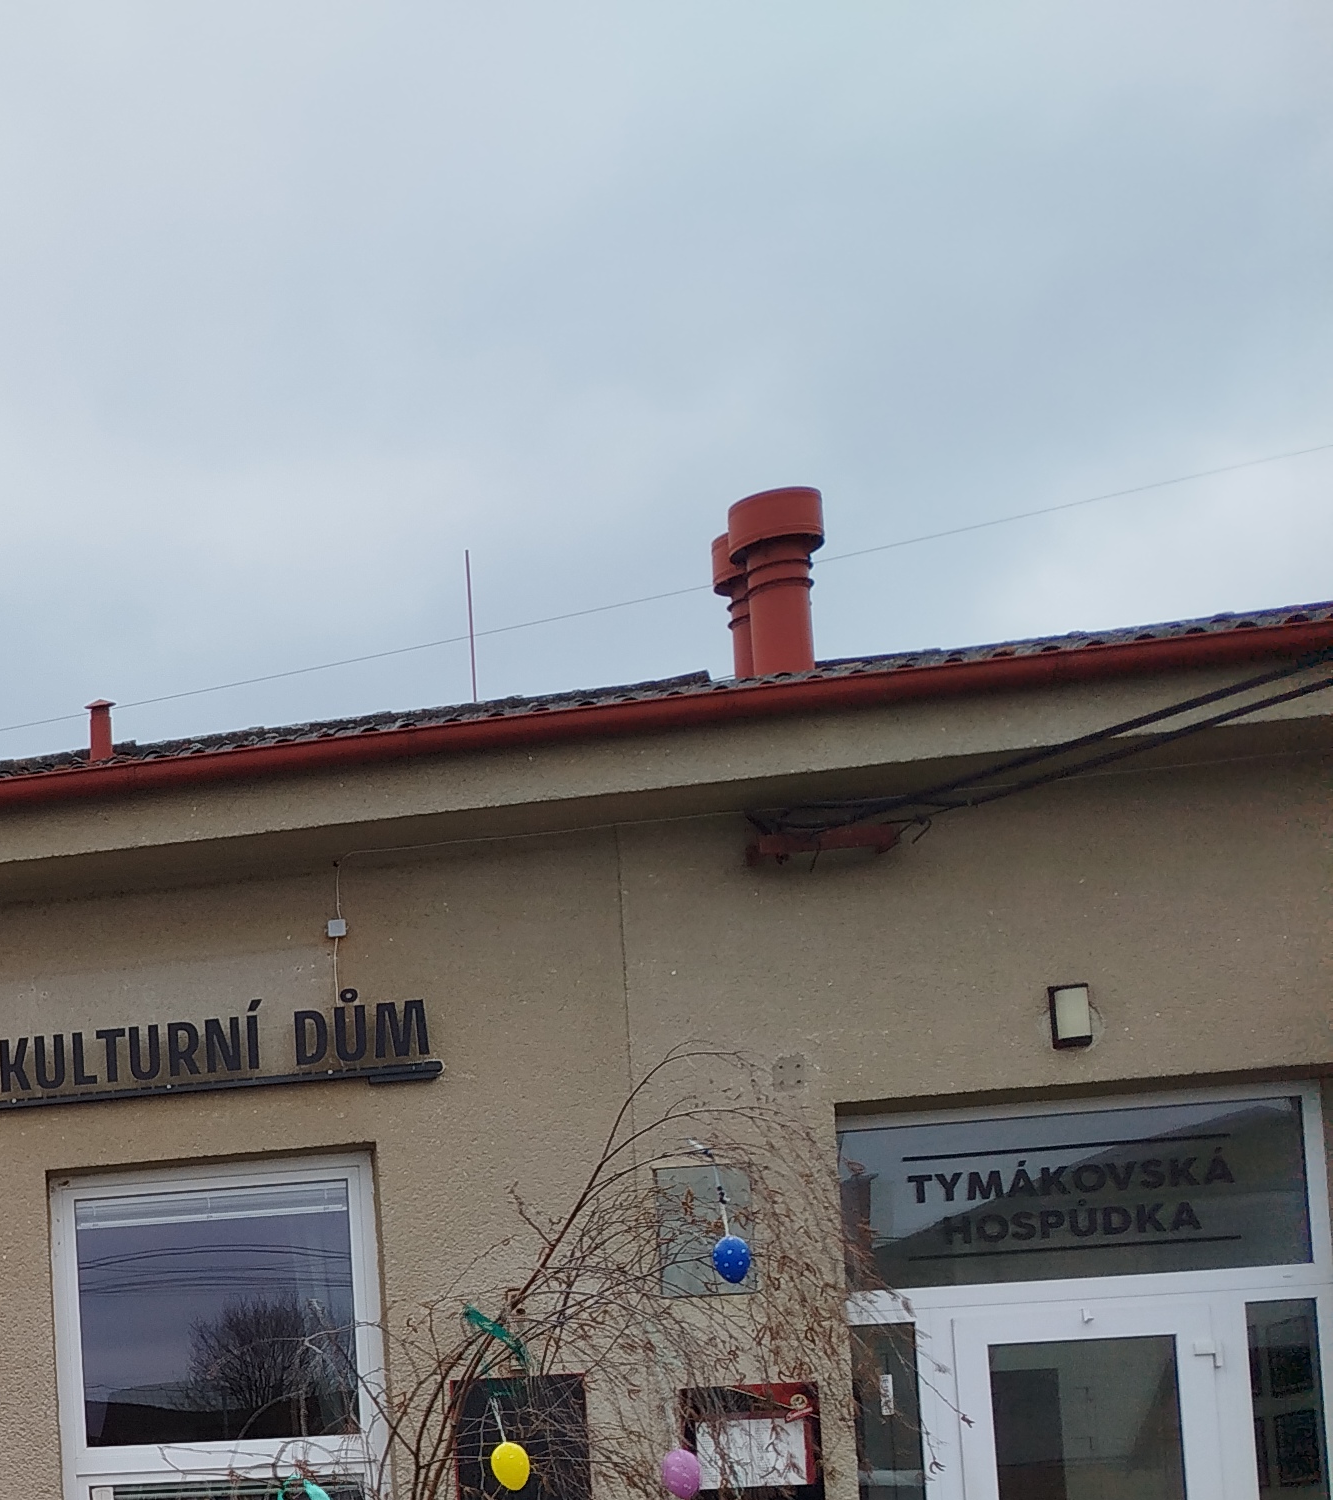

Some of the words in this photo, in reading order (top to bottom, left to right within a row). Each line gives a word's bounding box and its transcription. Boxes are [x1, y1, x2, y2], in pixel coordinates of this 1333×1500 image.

[0, 999, 262, 1092] KULTURNÍ
[293, 988, 430, 1066] DŮM
[907, 1146, 1235, 1204] TYMÁKOVSKÁ
[942, 1200, 1203, 1246] HOSPŮDKA
